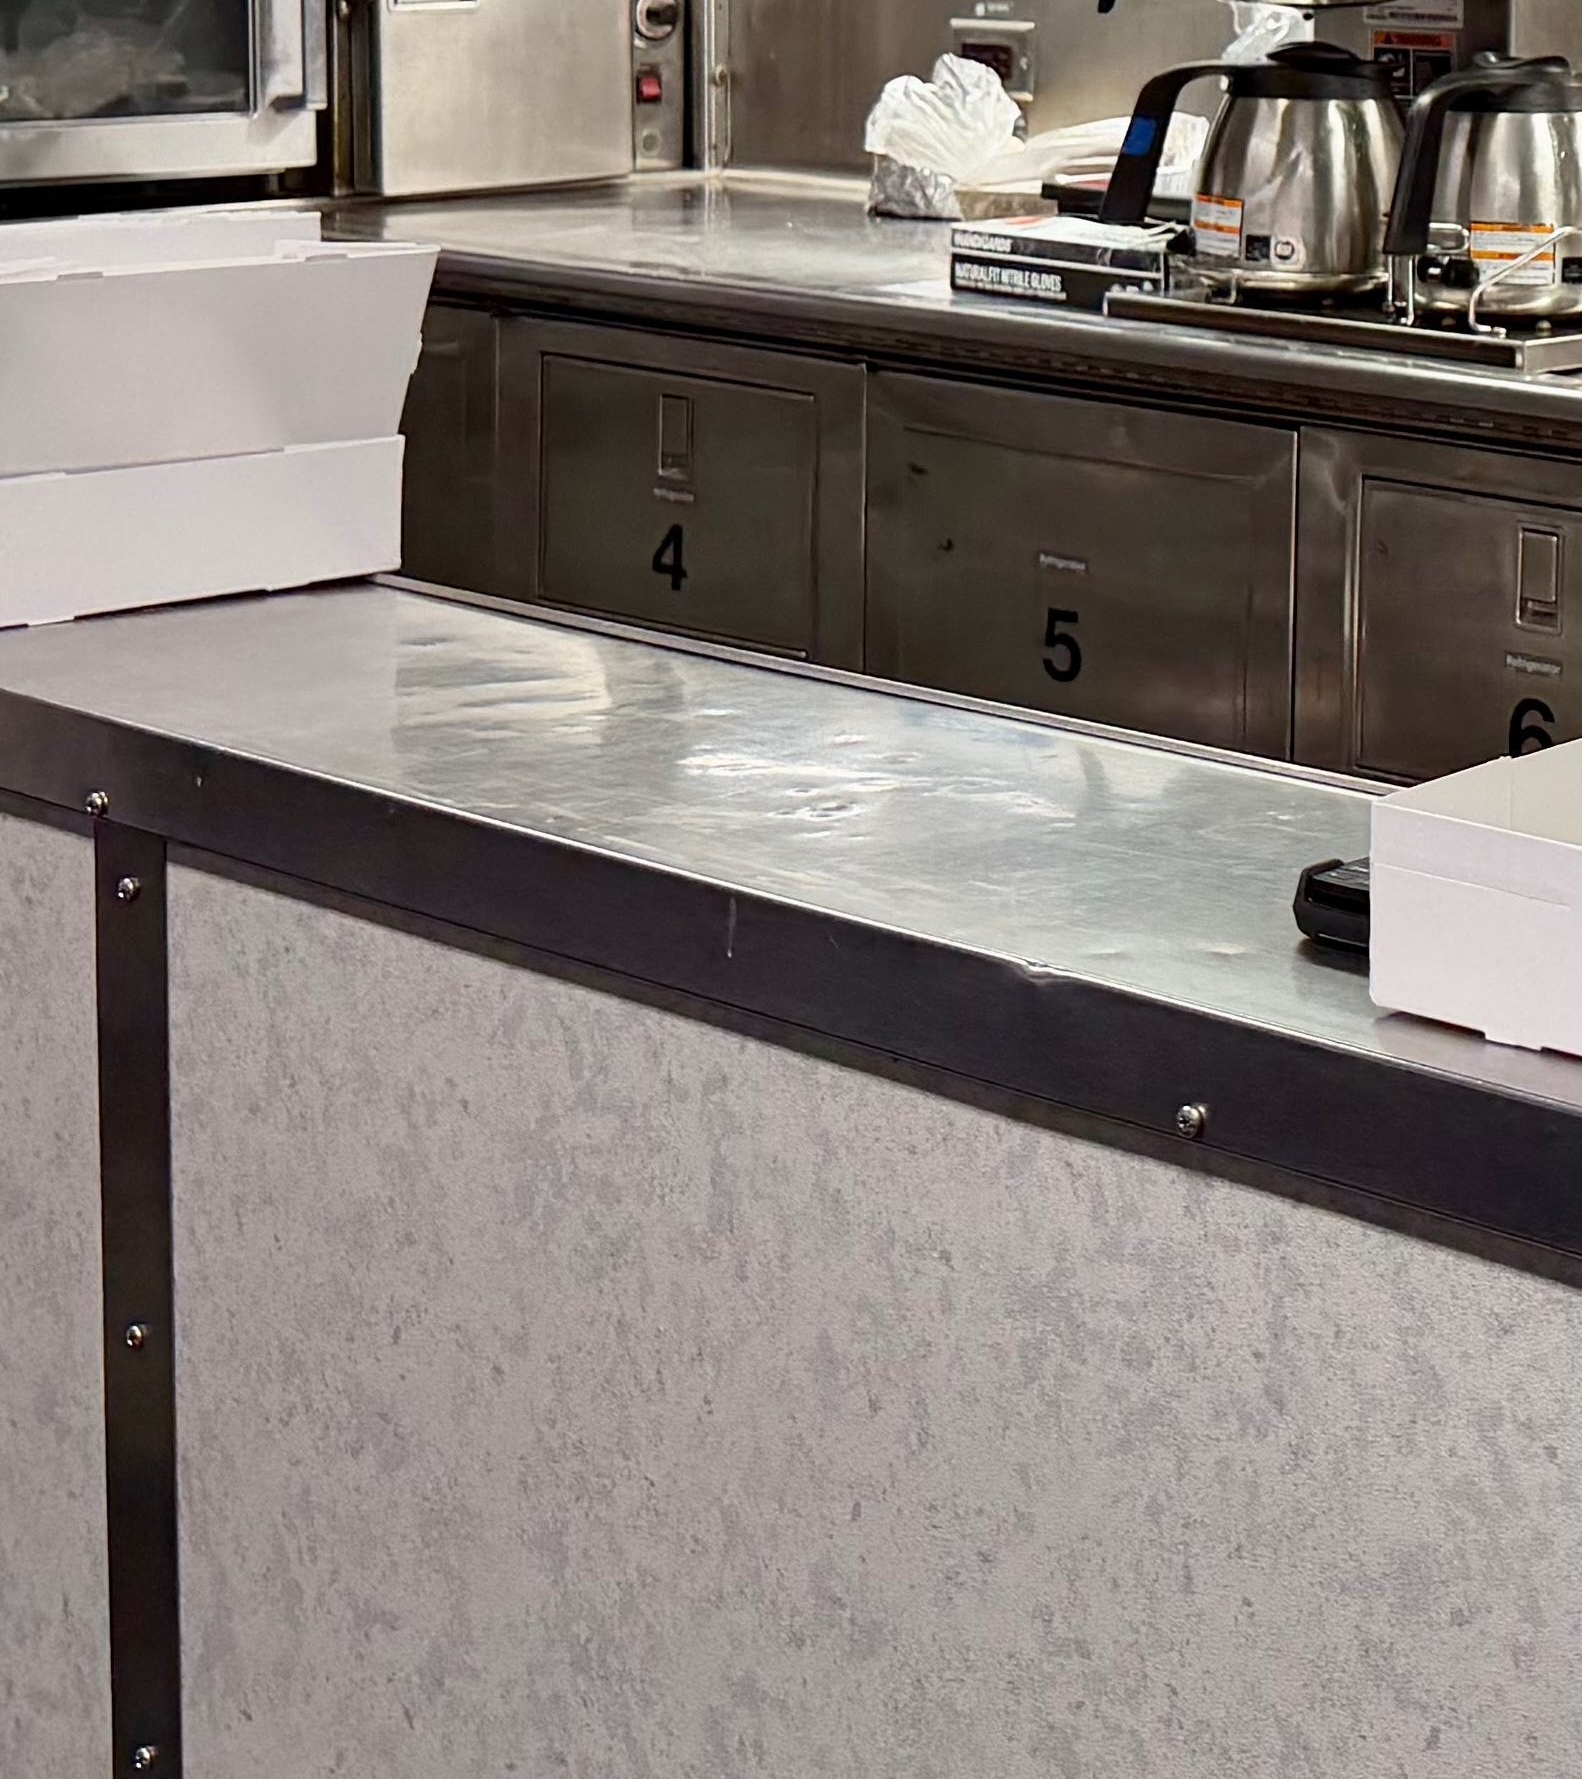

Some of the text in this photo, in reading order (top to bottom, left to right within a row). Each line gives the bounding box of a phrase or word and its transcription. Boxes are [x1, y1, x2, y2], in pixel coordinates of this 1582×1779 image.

[652, 523, 688, 591] 4
[1042, 607, 1082, 682] 5
[1508, 697, 1556, 758] 6
